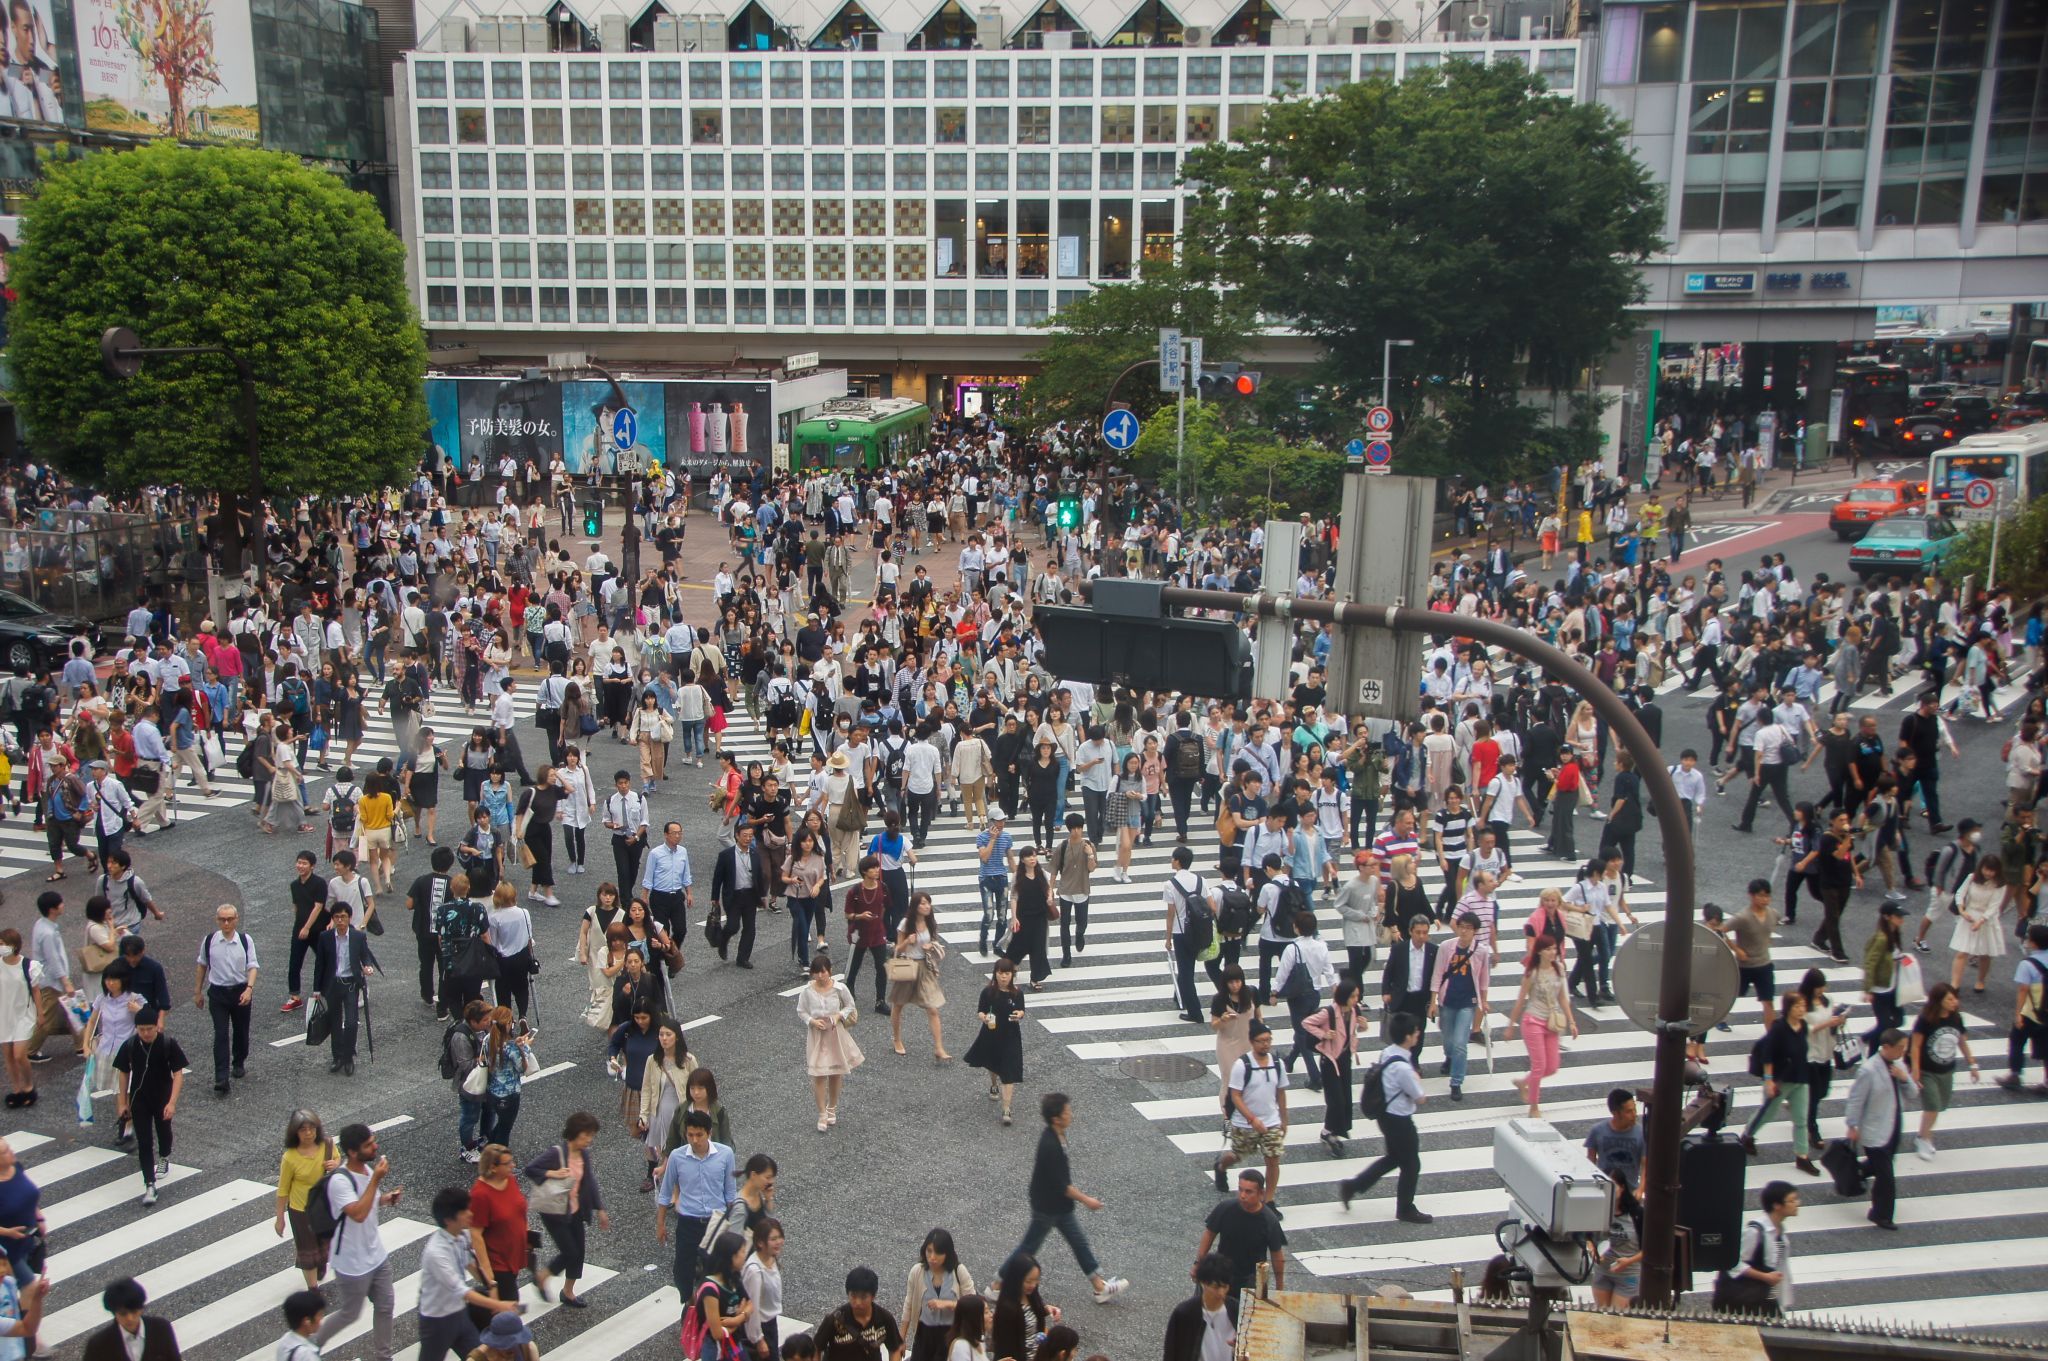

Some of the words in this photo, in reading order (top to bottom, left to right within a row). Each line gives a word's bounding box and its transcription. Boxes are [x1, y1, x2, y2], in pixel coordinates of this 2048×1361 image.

[89, 58, 127, 72] anniversary
[101, 71, 118, 83] BEST
[211, 125, 229, 137] NOW
[229, 127, 240, 138] ON
[240, 129, 257, 141] SALE
[1169, 335, 1178, 386] 渋谷駅前
[465, 418, 557, 437] 予防美髪の女。
